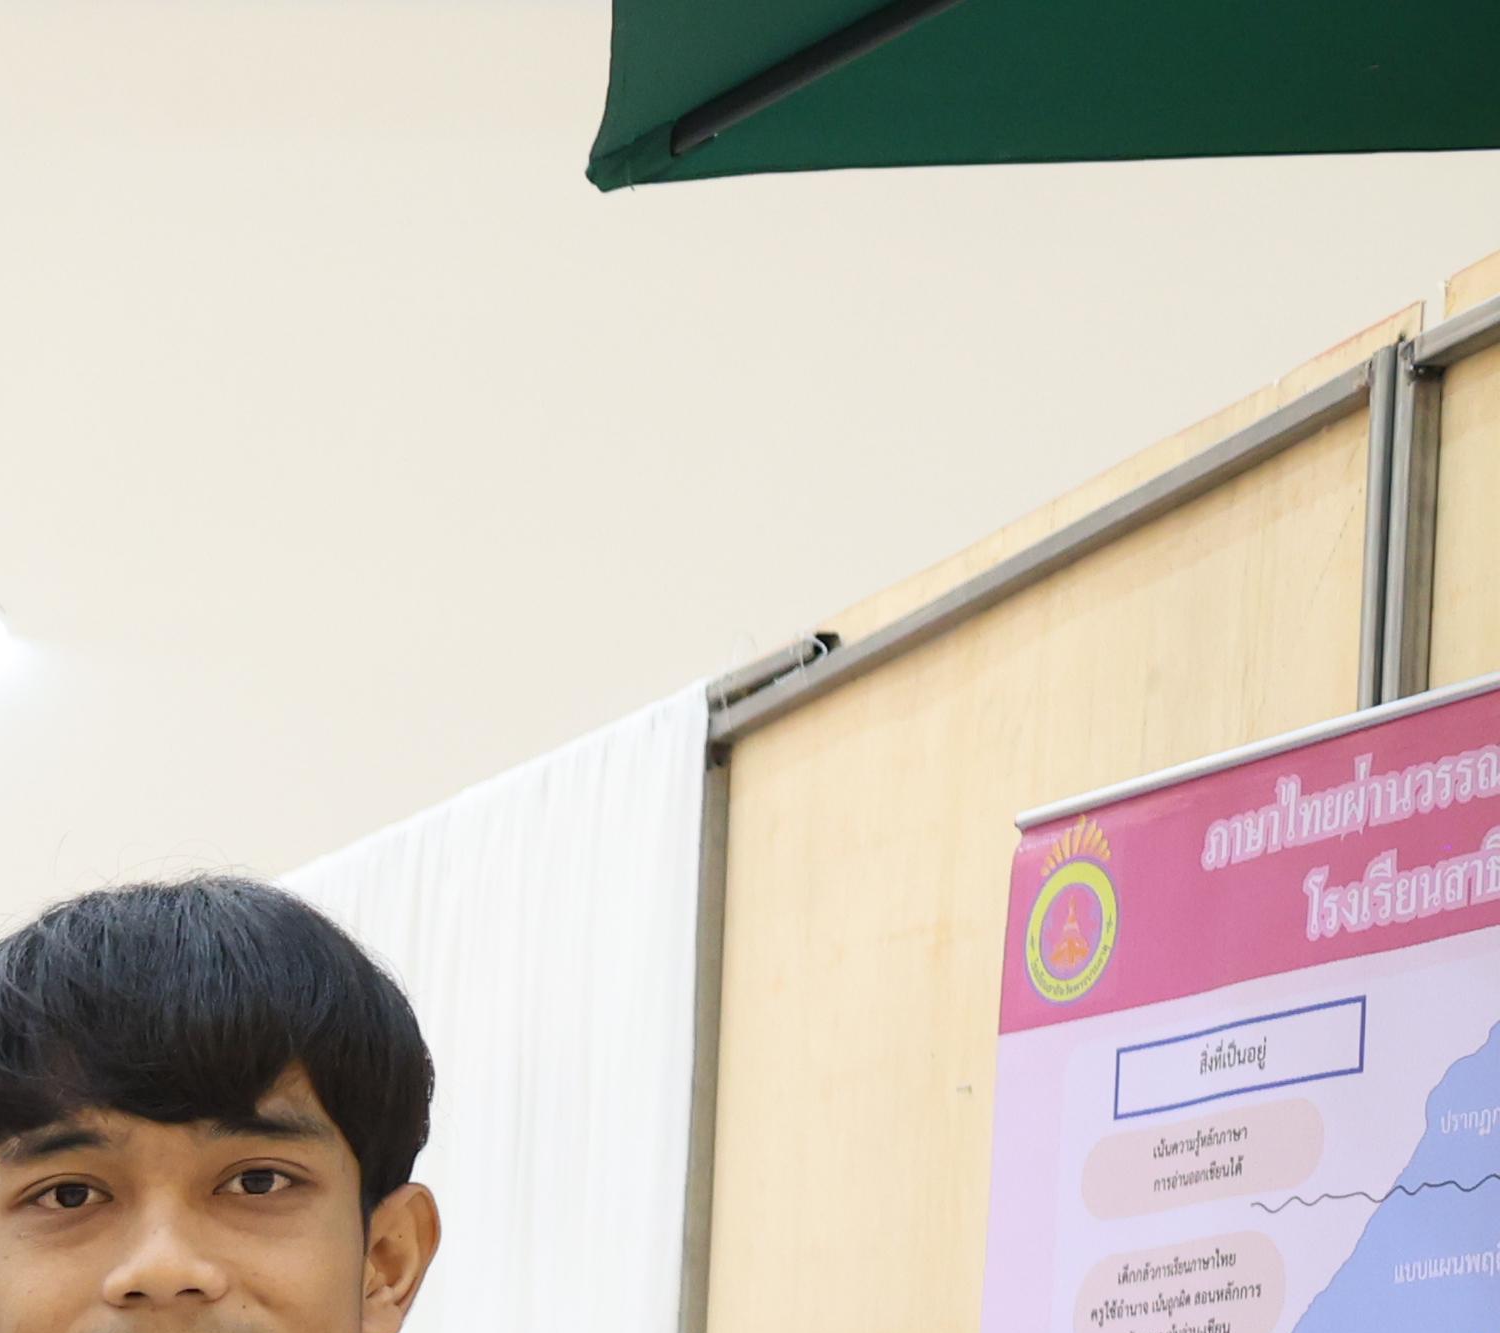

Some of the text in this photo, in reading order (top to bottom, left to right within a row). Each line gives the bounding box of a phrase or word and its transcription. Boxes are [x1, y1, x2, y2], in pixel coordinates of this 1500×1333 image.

[1200, 1036, 1267, 1075] สิ่งที่เป็นอยู่
